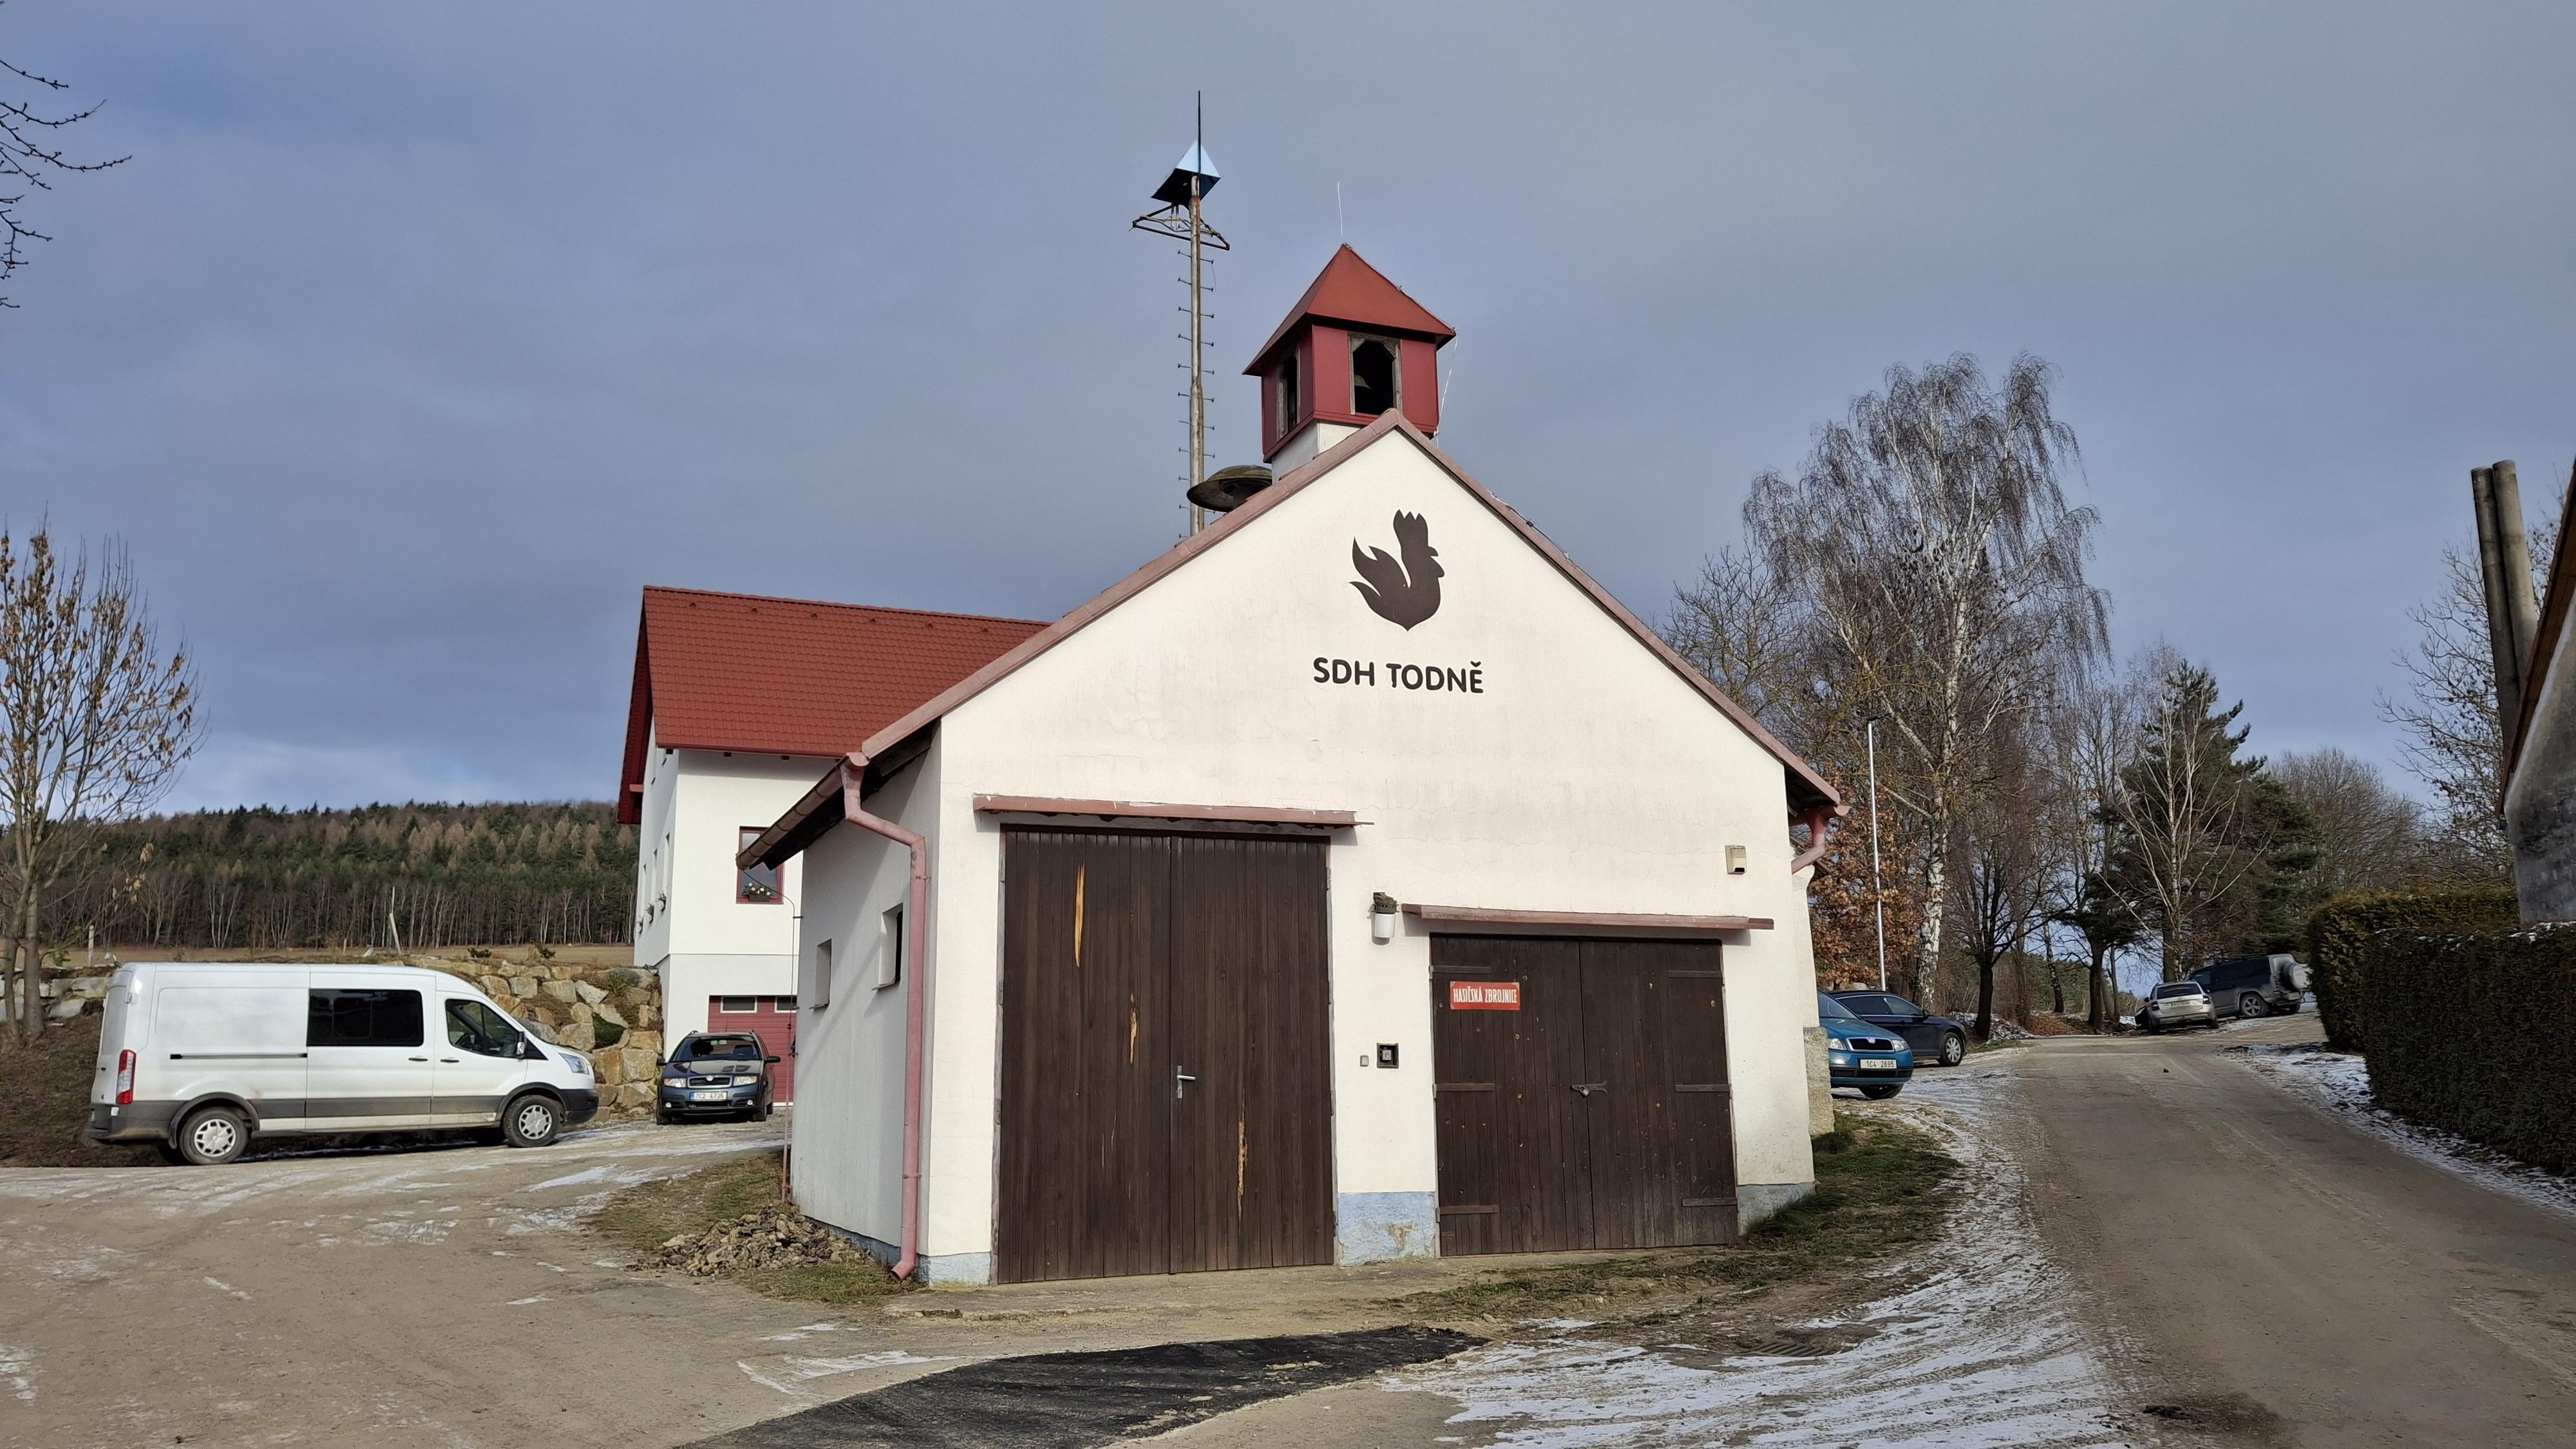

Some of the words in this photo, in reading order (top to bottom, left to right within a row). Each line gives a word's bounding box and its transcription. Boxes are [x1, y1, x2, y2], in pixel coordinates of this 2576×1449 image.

[1313, 657, 1375, 687] SDH
[1386, 661, 1484, 693] TODNĚ
[1453, 986, 1483, 1003] HASIČSKÁ
[1484, 989, 1517, 1003] ZBROJNICE
